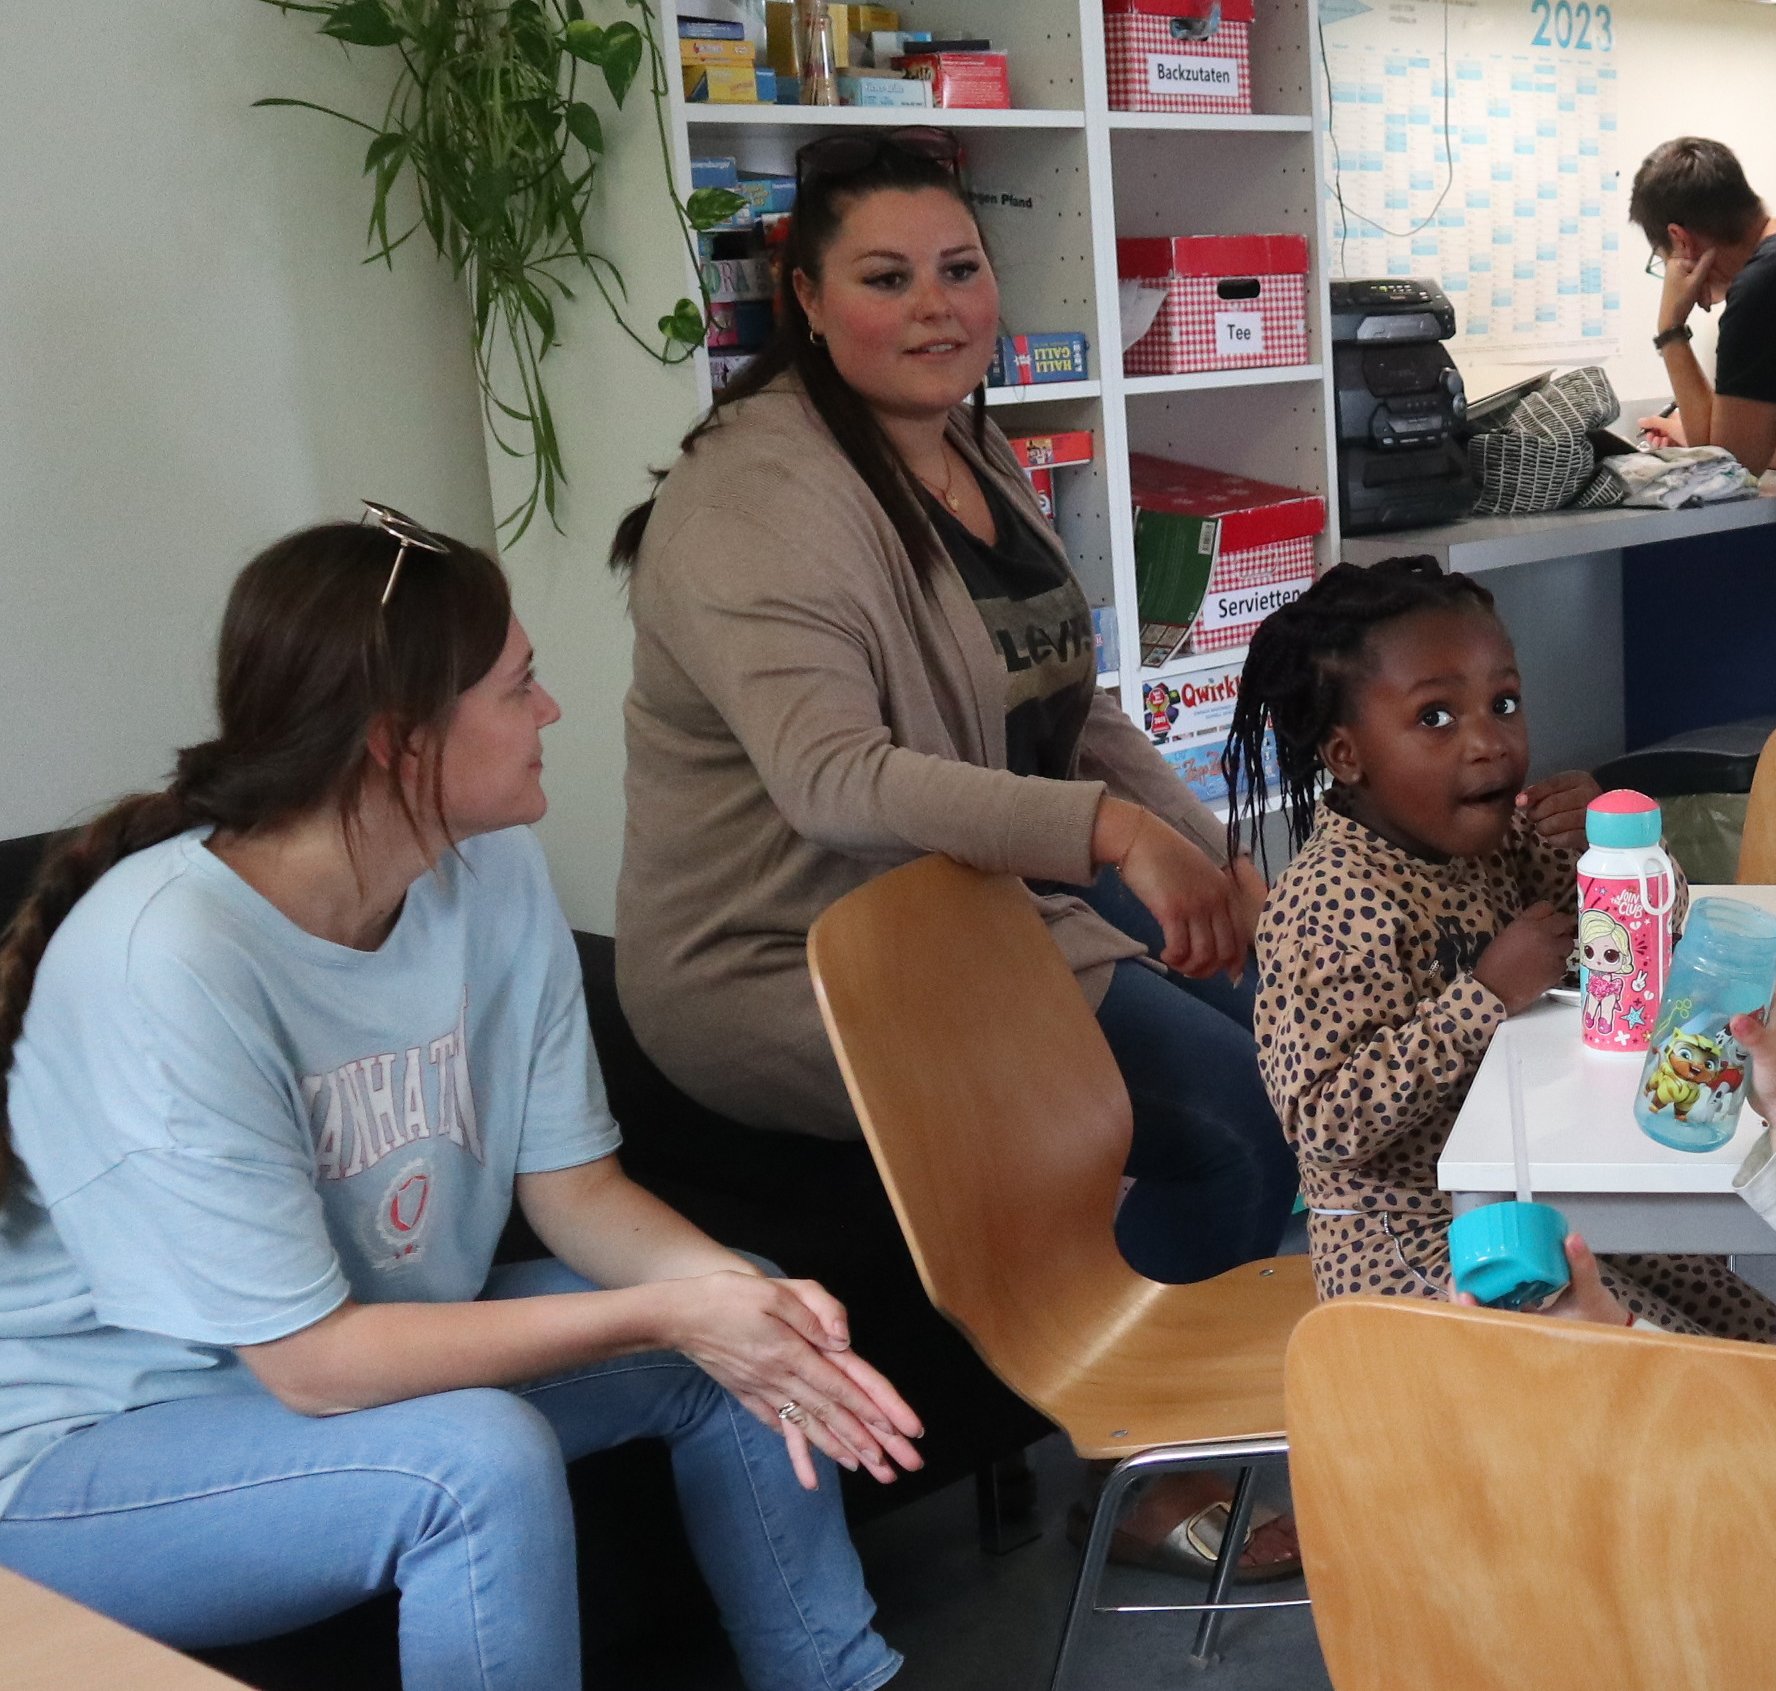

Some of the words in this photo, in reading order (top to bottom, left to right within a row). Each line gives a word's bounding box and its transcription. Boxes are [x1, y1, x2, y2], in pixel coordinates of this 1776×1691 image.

[1530, 0, 1612, 51] 2023
[1157, 63, 1230, 83] Backzutaten
[1226, 323, 1251, 340] Tee
[1034, 346, 1071, 360] GALLI
[1036, 359, 1072, 373] HALLI
[1218, 588, 1301, 619] Servietten
[1617, 889, 1641, 904] JOIN
[1619, 901, 1643, 918] CLUB
